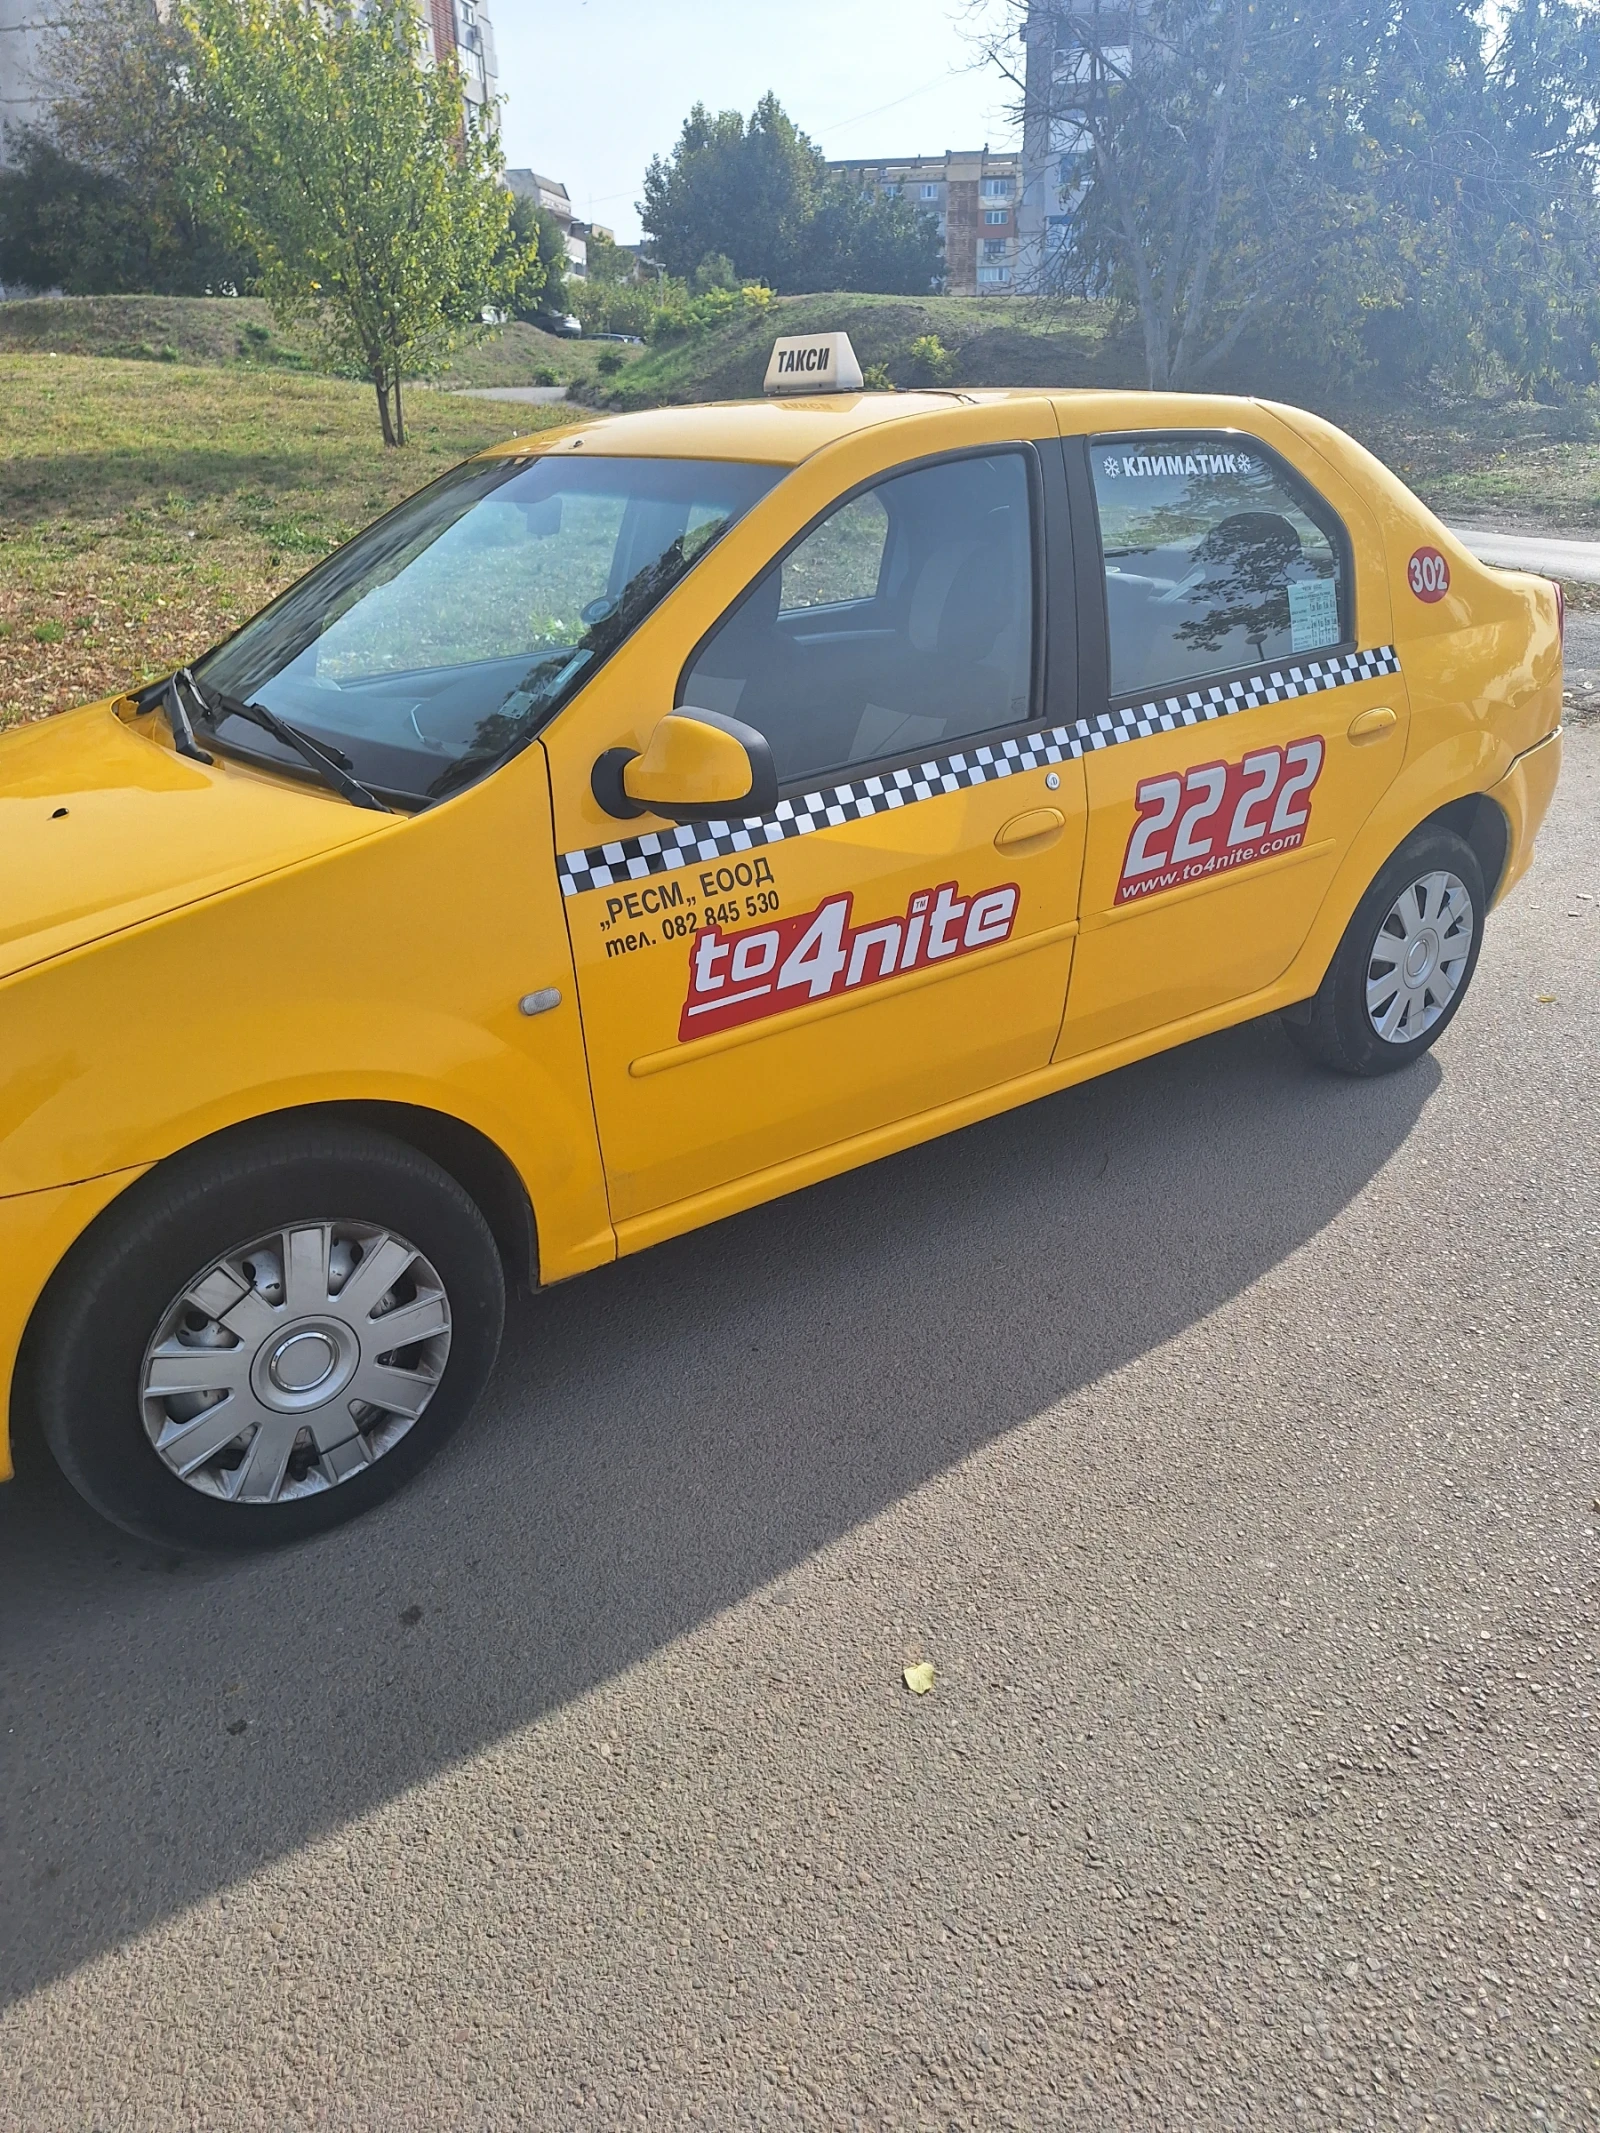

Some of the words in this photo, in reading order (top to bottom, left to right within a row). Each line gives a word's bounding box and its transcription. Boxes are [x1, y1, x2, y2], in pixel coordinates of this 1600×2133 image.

[778, 348, 830, 373] ТАКСИ
[1122, 453, 1238, 477] КЛИМАТИК
[1410, 556, 1448, 593] 302
[699, 857, 775, 897] ЕООД
[1122, 833, 1301, 899] www.to4nite.com
[661, 912, 700, 941] 082
[704, 900, 740, 926] 845
[745, 890, 780, 917] 530
[694, 887, 1017, 998] to4nite
